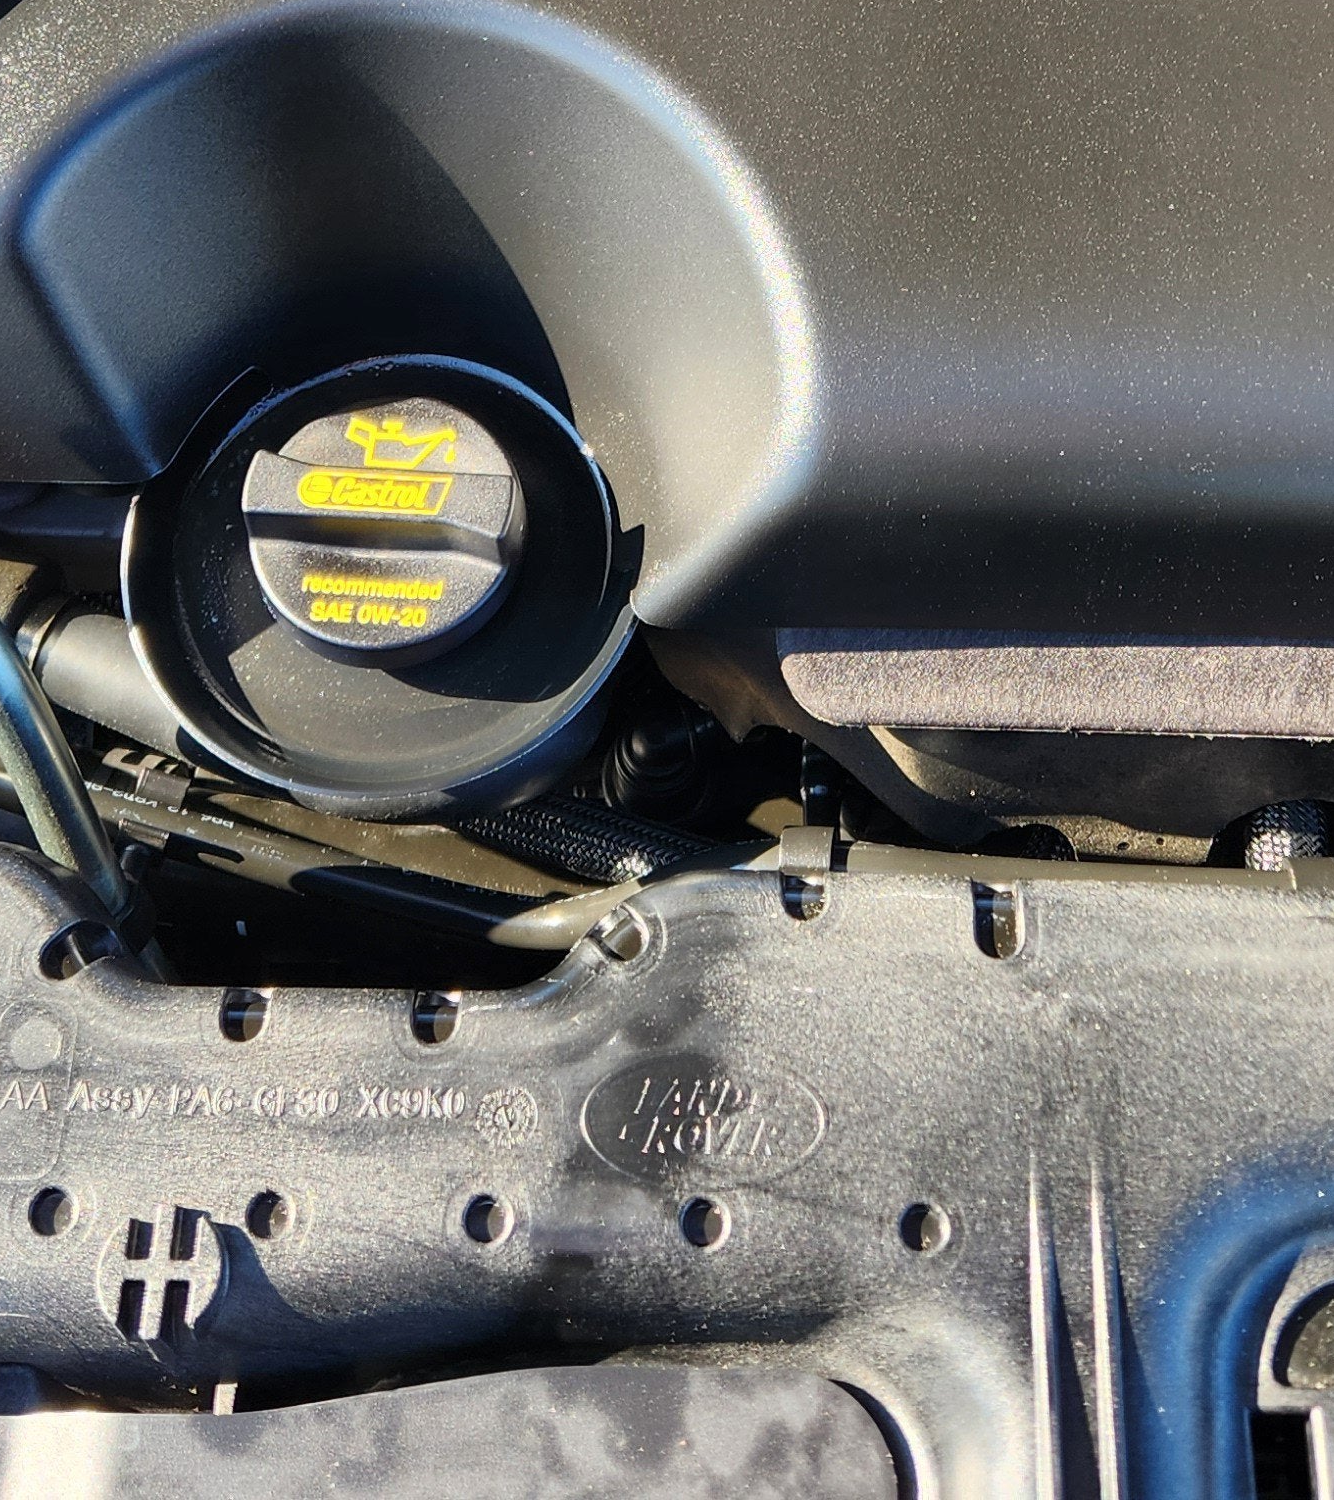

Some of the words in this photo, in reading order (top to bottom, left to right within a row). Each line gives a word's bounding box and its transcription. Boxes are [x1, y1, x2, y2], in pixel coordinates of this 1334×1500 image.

[330, 477, 432, 509] Castrol
[301, 574, 445, 601] recommended
[310, 601, 354, 624] SAE
[357, 602, 428, 628] 0W-20
[0, 1080, 52, 1112] AA
